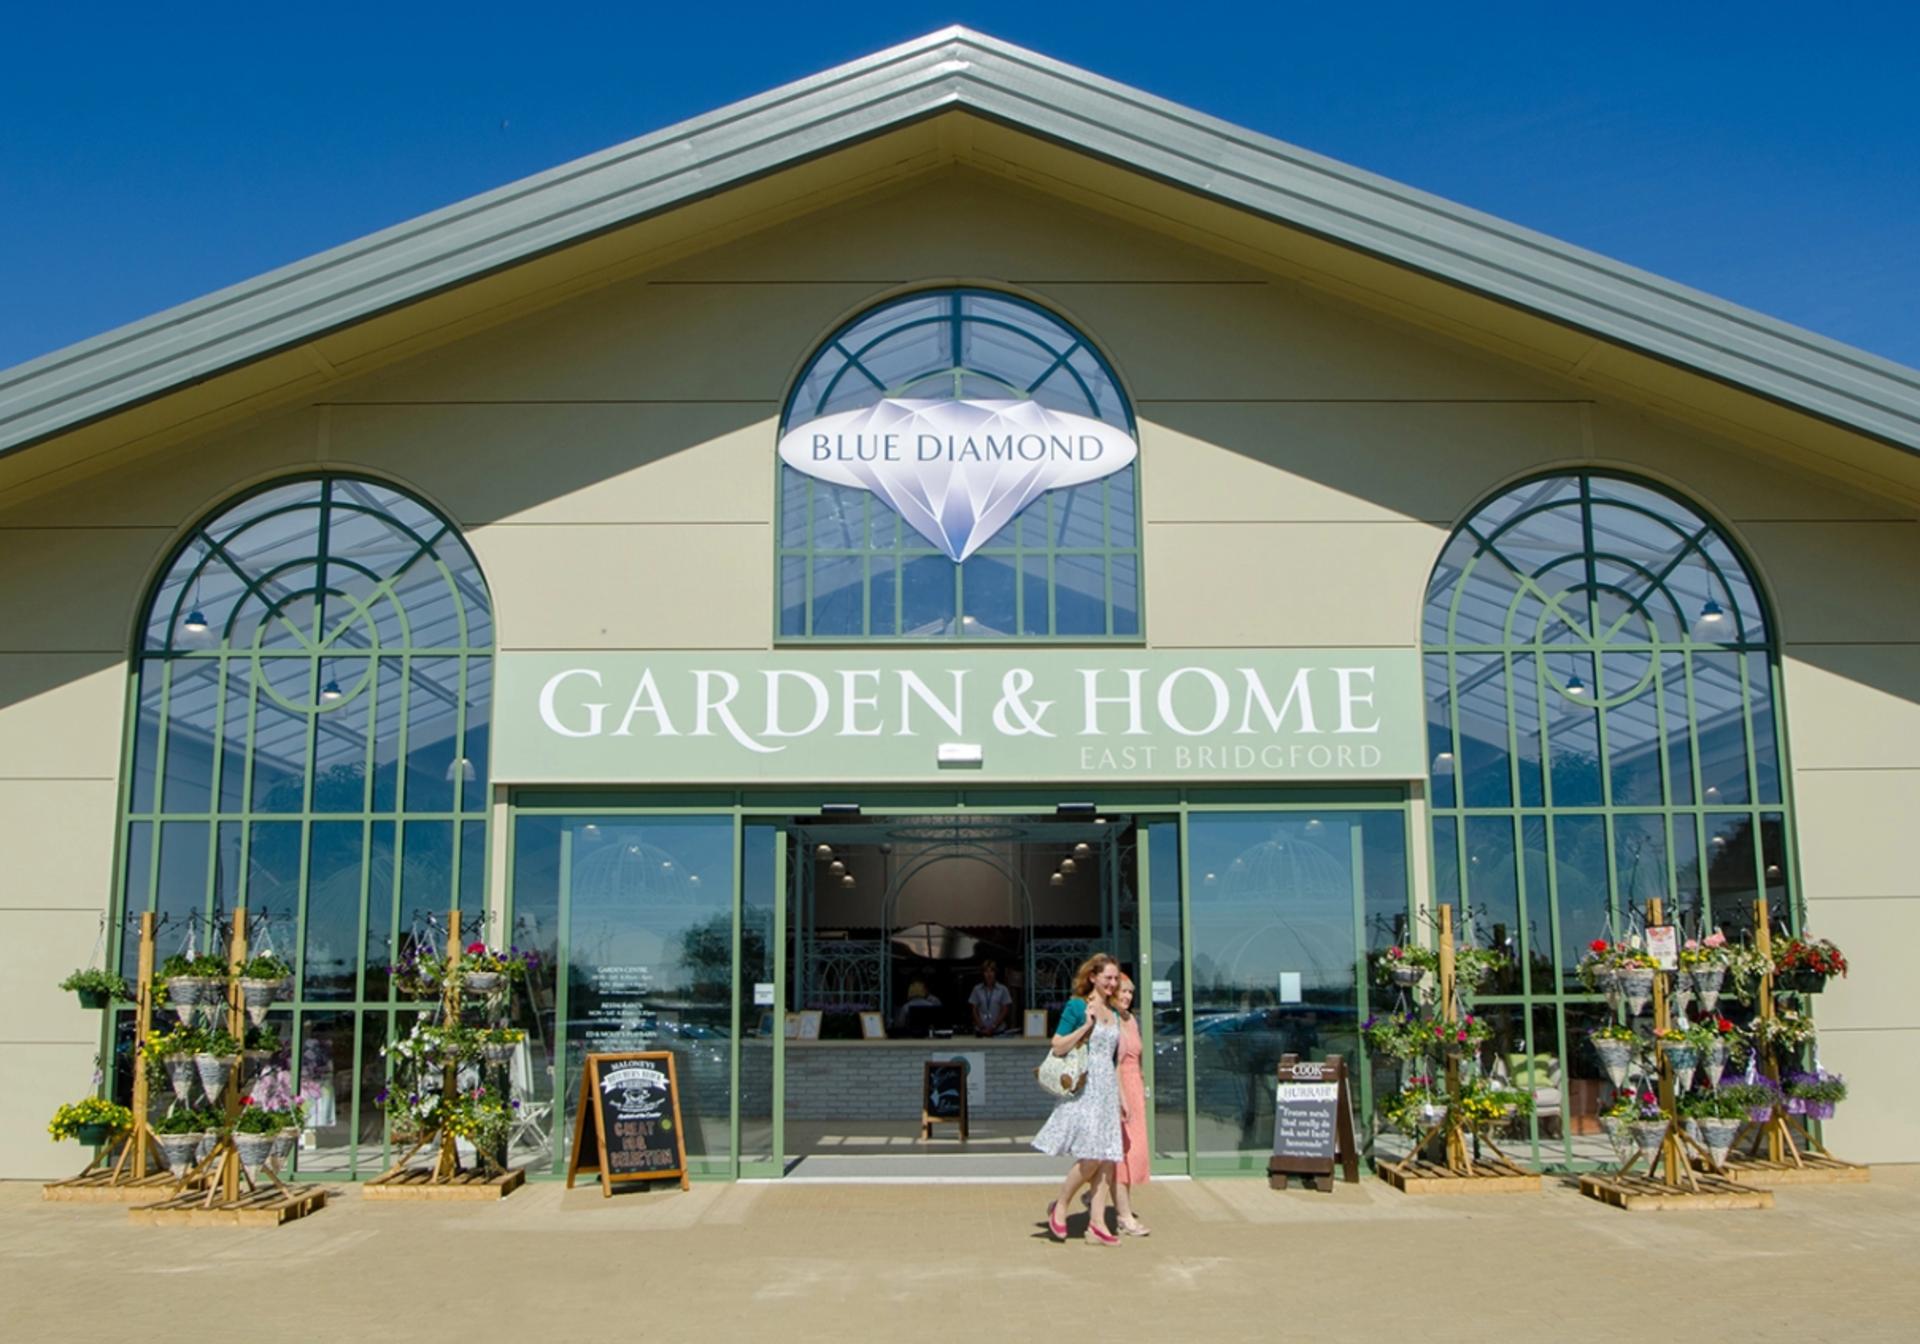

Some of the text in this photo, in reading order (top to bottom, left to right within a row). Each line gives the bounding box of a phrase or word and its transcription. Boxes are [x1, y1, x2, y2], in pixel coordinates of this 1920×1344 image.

[811, 433, 1105, 462] BLUE DIAMOND
[538, 665, 1381, 753] GARDEN & HOME
[1080, 745, 1382, 770] EAST BRIDGFORD
